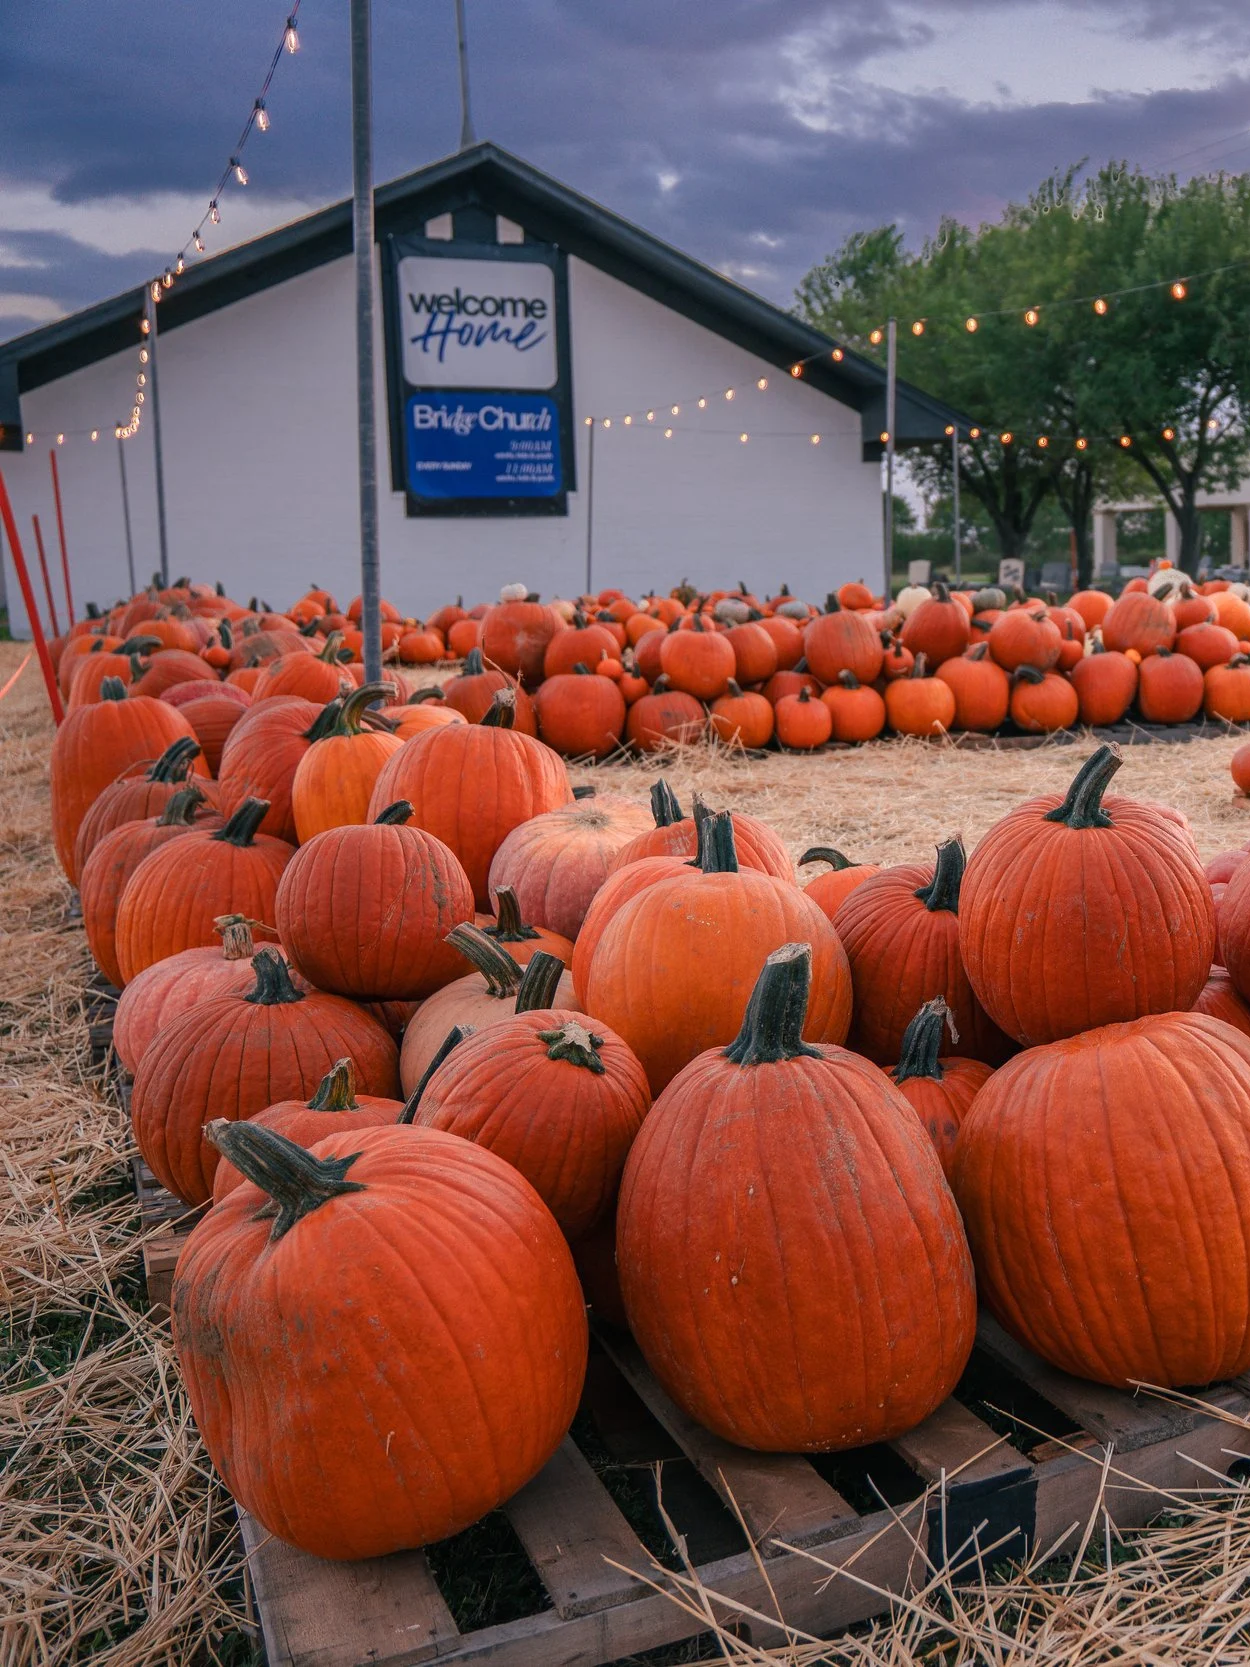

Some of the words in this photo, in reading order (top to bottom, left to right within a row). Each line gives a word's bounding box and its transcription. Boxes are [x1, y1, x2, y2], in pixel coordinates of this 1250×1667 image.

[409, 287, 547, 319] welcome
[410, 310, 548, 363] Home
[413, 404, 477, 436] Bridge
[478, 405, 552, 431] Church
